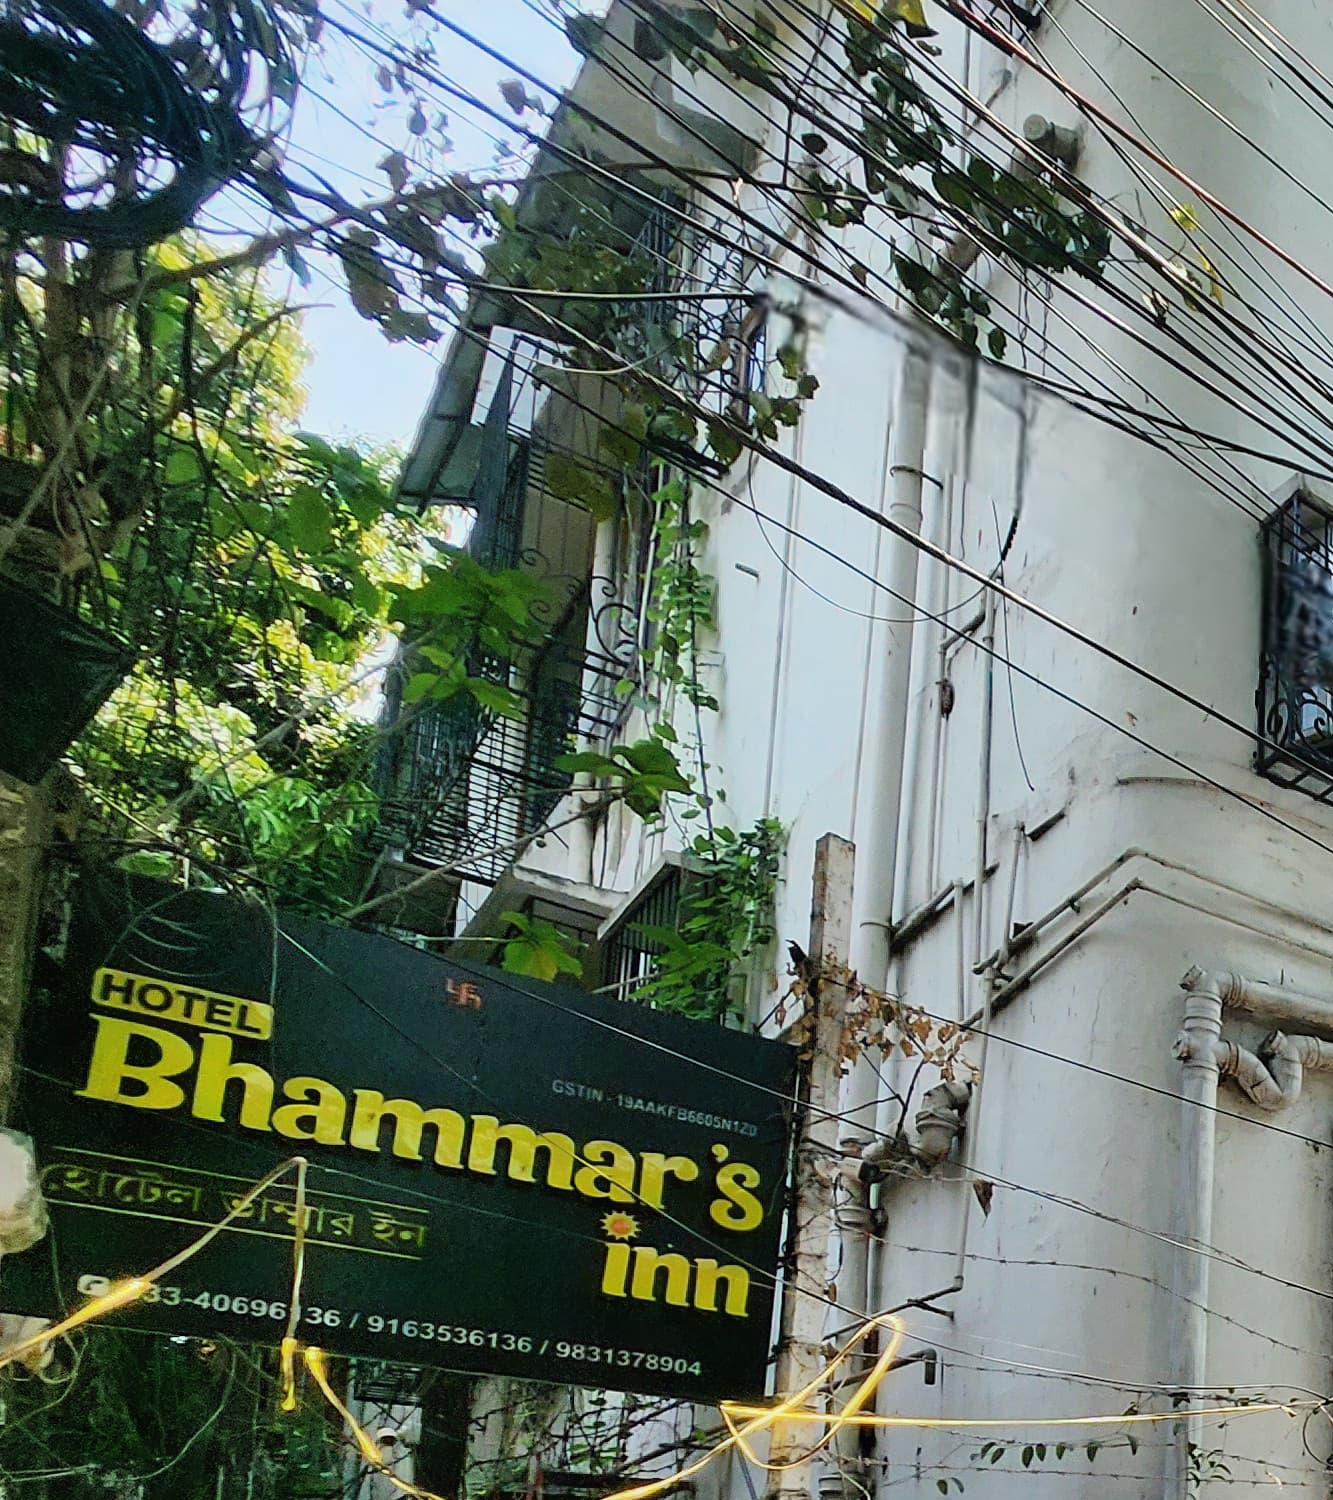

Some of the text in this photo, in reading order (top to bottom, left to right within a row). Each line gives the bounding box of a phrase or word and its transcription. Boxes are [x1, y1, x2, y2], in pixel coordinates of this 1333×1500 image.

[100, 972, 263, 1034] HOTEL
[551, 1078, 603, 1103] GSTIN
[73, 1012, 765, 1232] Bhammar's
[366, 1314, 535, 1354] 9163536136
[554, 1340, 702, 1377] 9831378904
